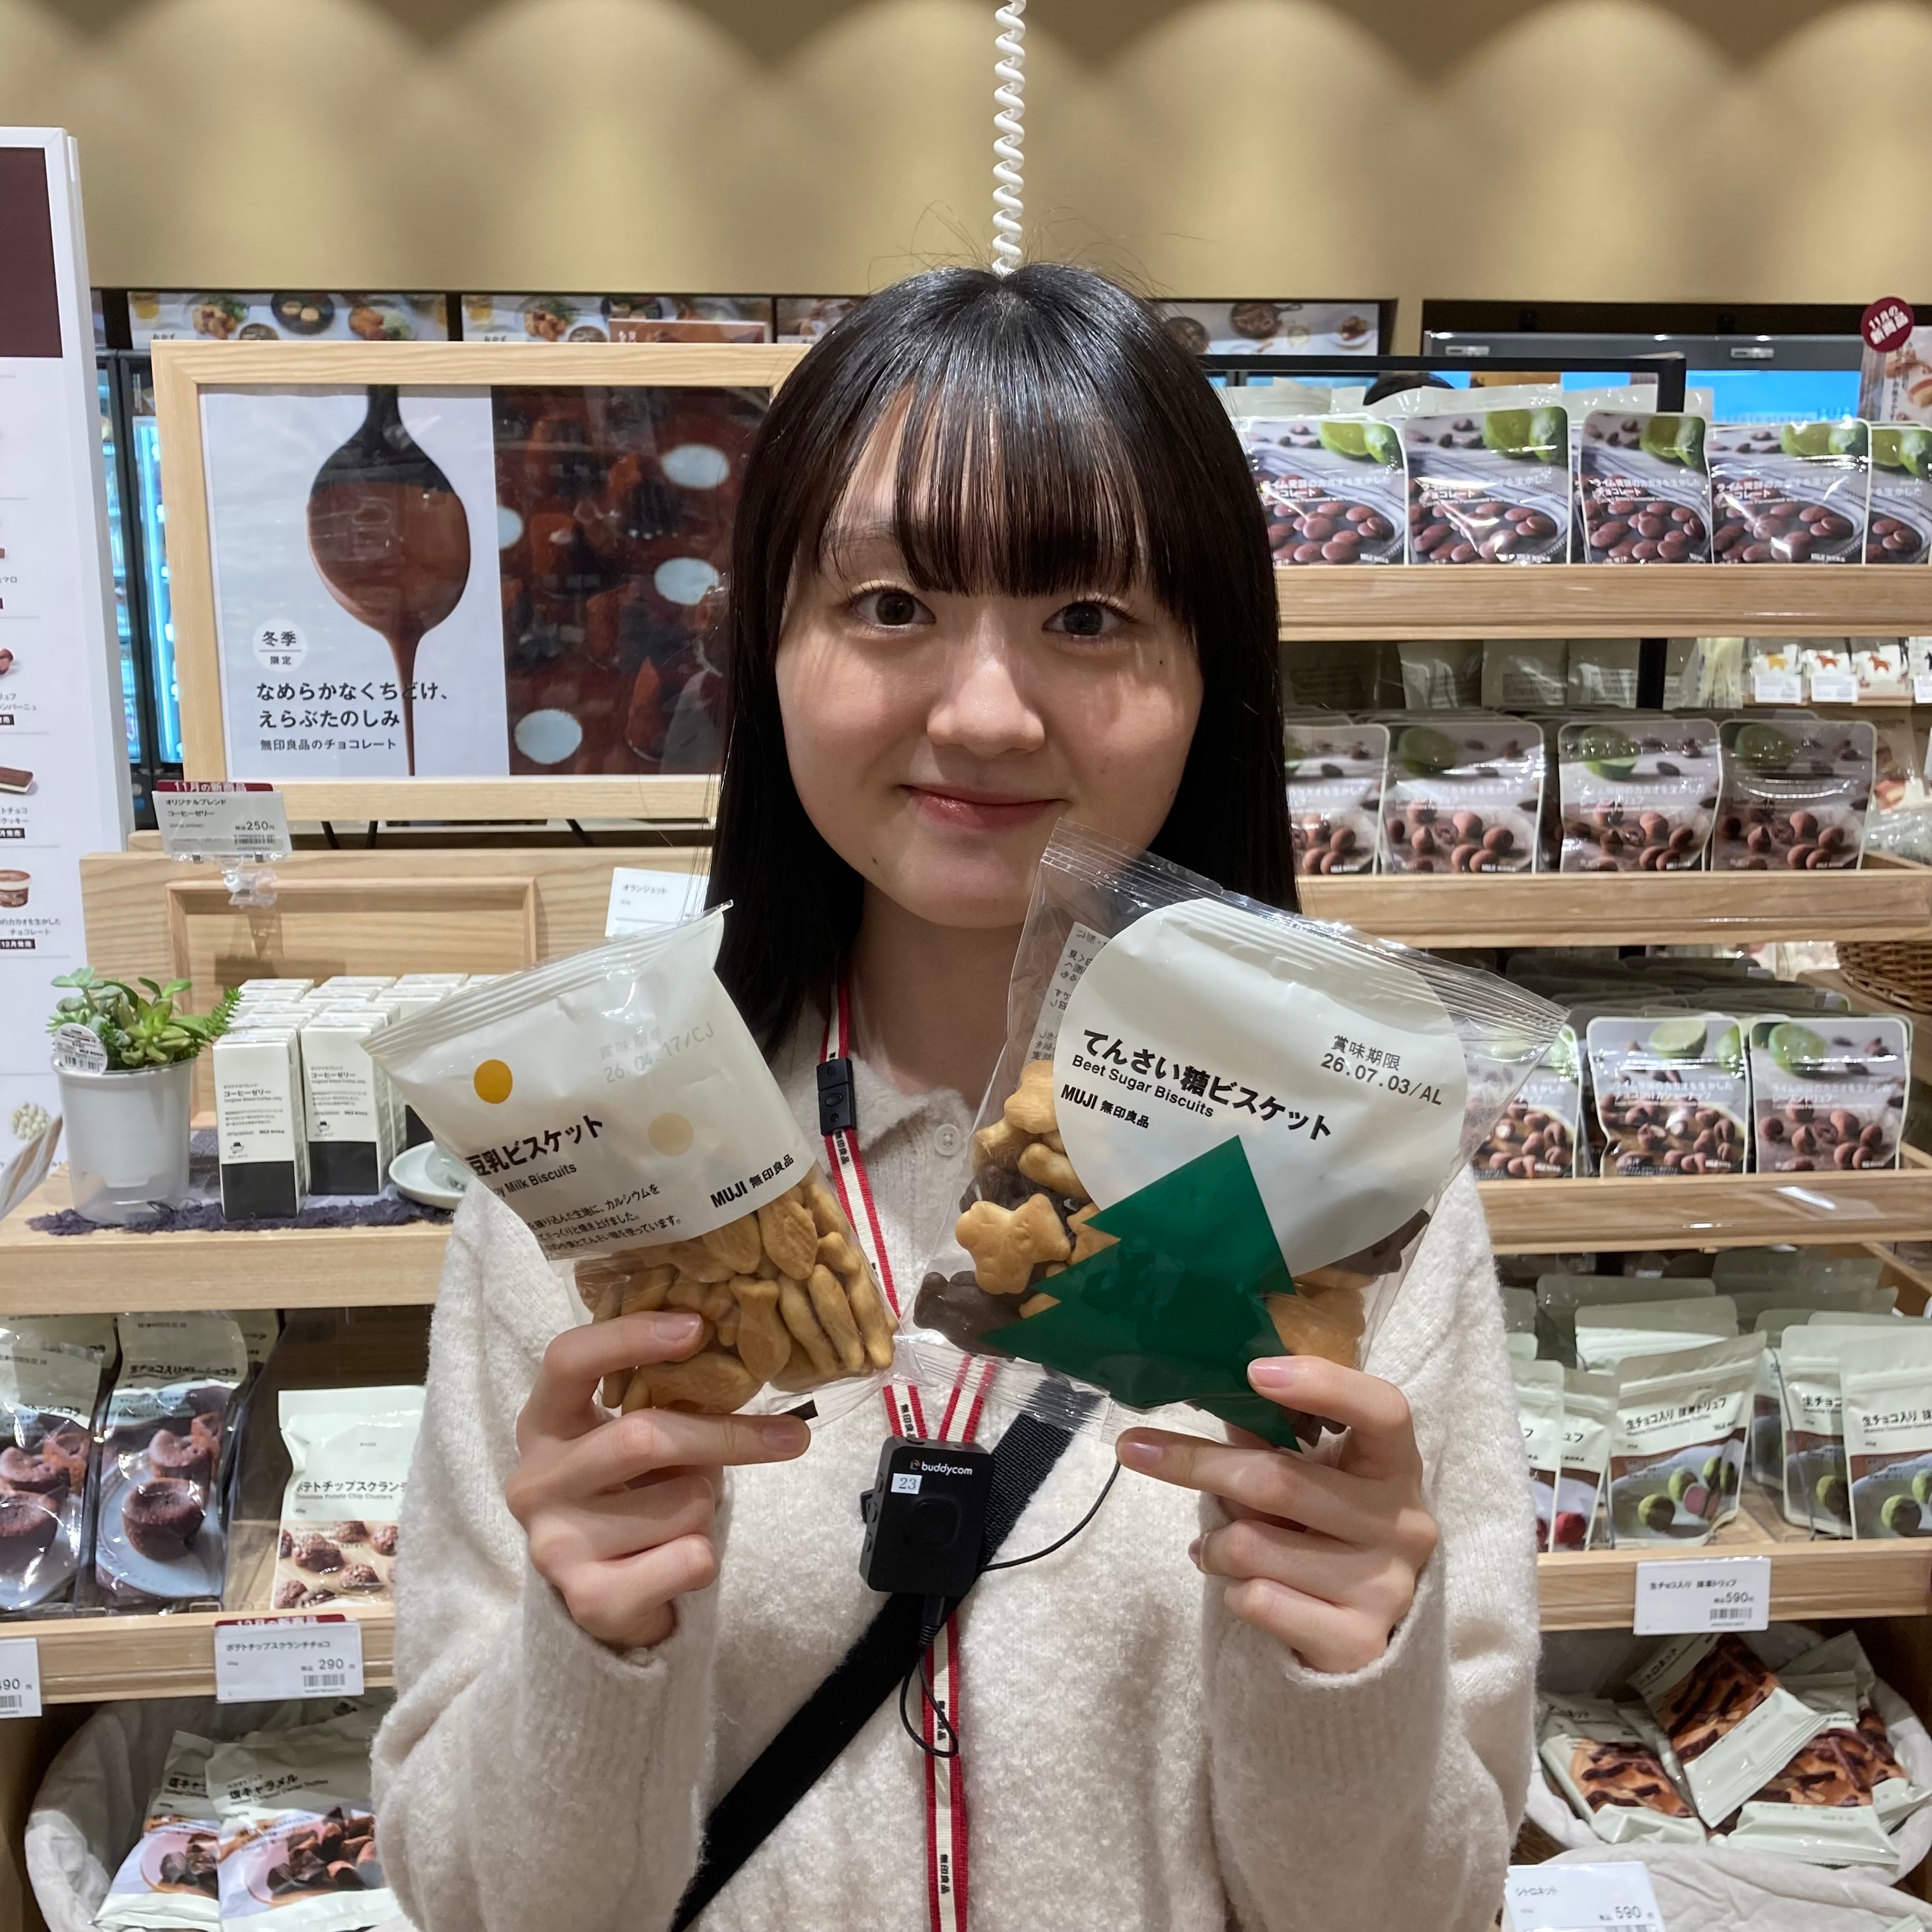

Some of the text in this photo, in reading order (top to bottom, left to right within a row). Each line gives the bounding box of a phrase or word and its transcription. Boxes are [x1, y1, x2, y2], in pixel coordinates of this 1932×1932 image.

[262, 631, 297, 647] 冬季
[270, 656, 292, 665] 限定
[256, 682, 447, 701] なめらかなくちどけ、
[259, 709, 400, 728] えらぶたのしみ
[260, 739, 396, 751] 無印良品のチョコレート
[604, 1022, 714, 1083] 26.04.17/CJ
[1331, 1034, 1402, 1071] 賞味期限
[1072, 1054, 1215, 1118] Beet Sugar Biscuits
[1083, 1029, 1331, 1140] てんさい糖ビスケット
[1321, 1052, 1442, 1106] 26.07.03/AL
[1061, 1084, 1149, 1129] MUJI 無印良品
[464, 1114, 604, 1177] 豆乳ビスケット
[504, 1178, 528, 1193] Milk
[528, 1163, 578, 1186] Biscuits
[710, 1153, 794, 1208] MUJI 無印良品
[921, 1461, 973, 1476] buddycom
[898, 1477, 917, 1490] 23
[318, 1658, 344, 1671] 290
[0, 1678, 20, 1690] 90
